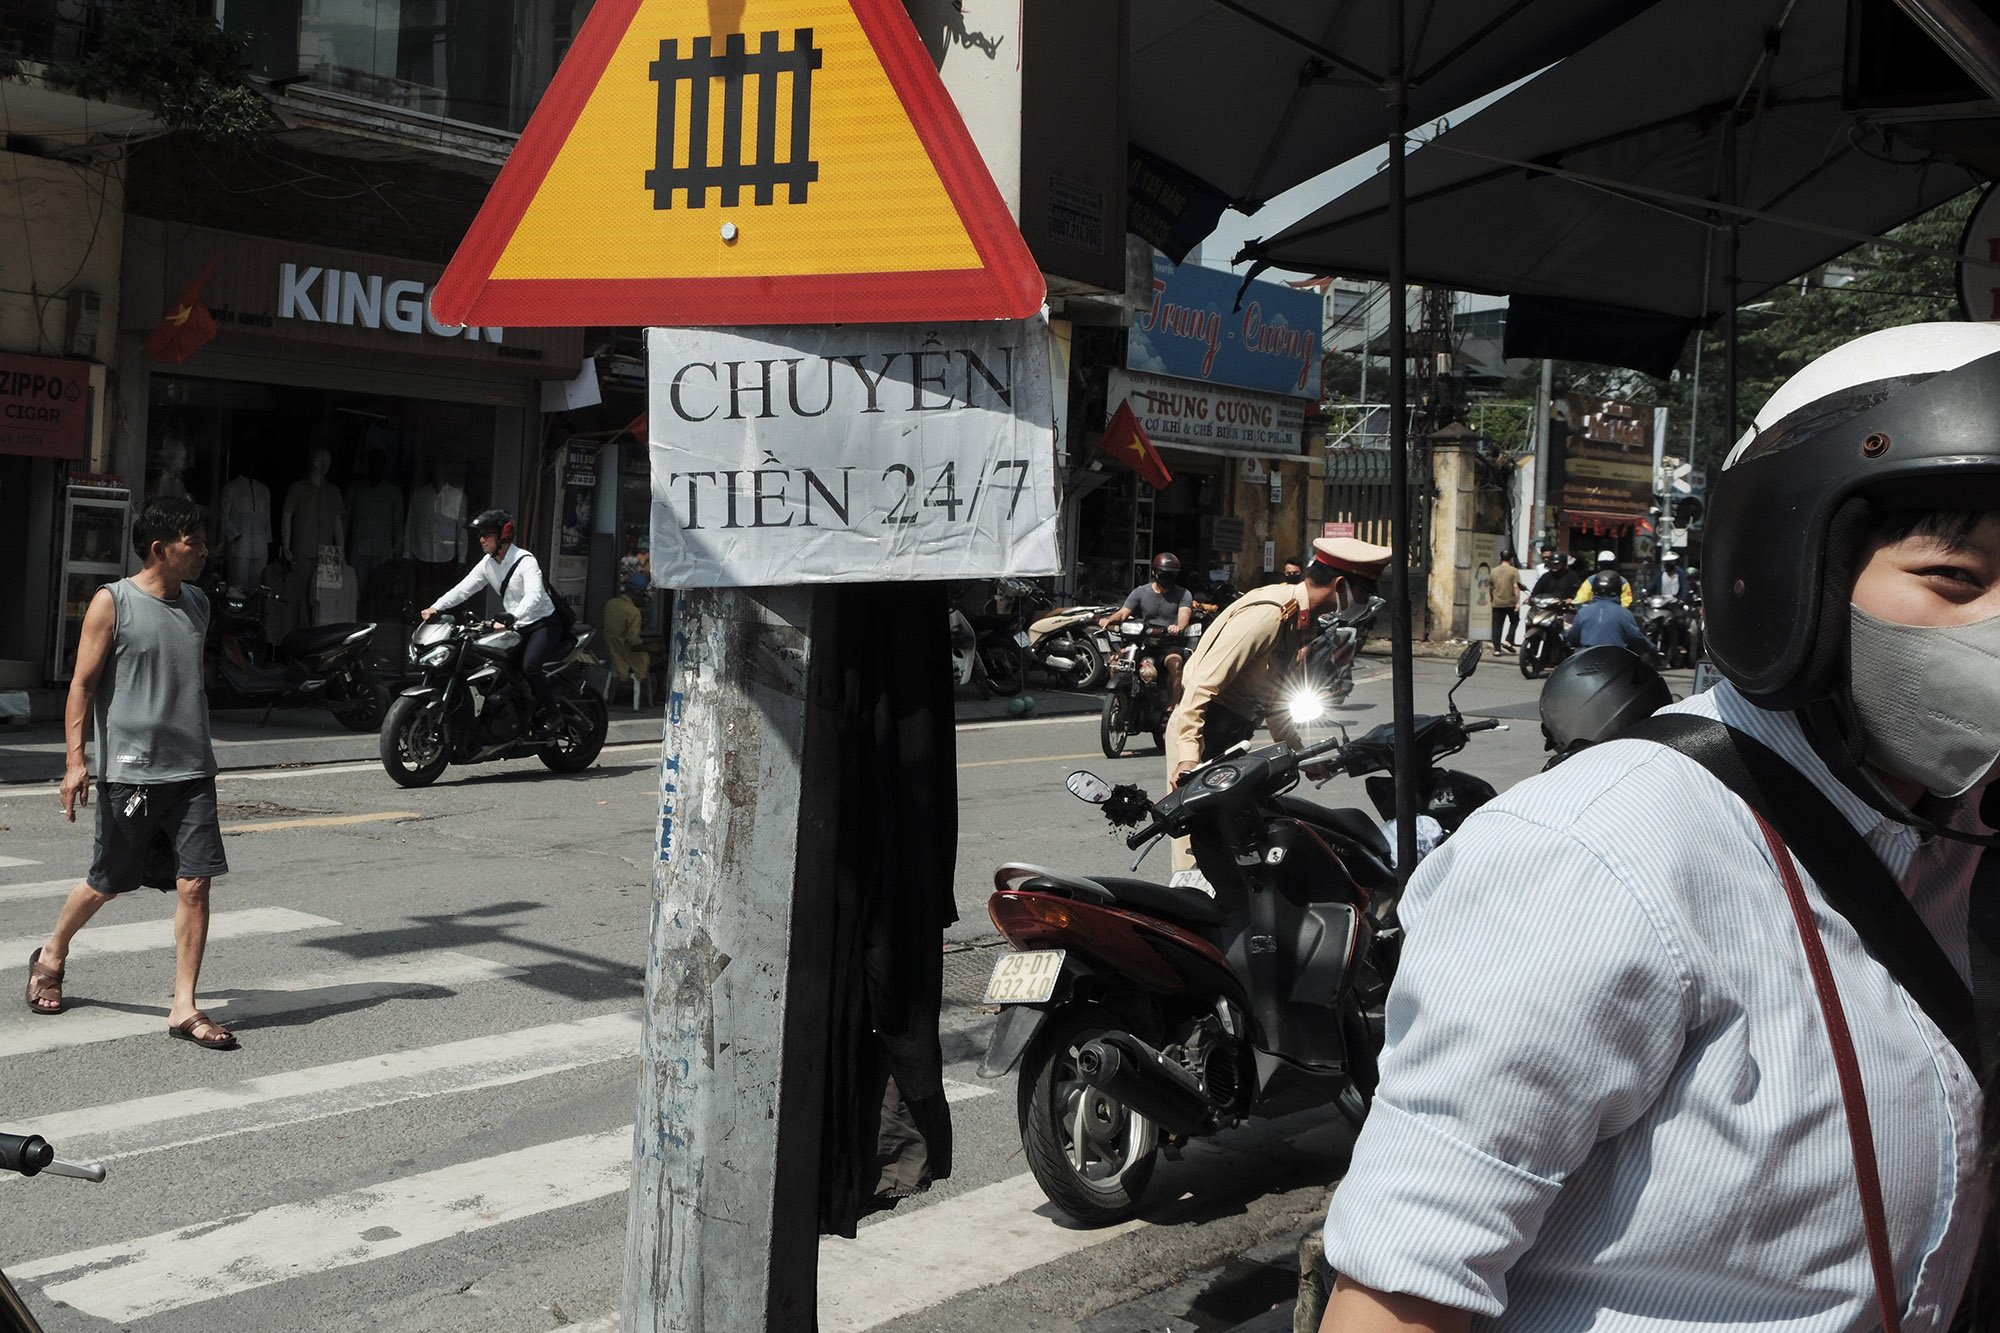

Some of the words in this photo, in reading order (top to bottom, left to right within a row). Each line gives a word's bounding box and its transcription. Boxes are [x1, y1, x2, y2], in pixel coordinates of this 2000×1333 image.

[278, 263, 503, 343] KING
[1143, 278, 1222, 378] Trung
[1242, 301, 1315, 391] Cương
[0, 370, 63, 400] ZIPPO
[670, 331, 1018, 422] CHUYỂN
[5, 404, 64, 423] CIGAR
[1147, 390, 1209, 420] TRUNG
[1215, 400, 1272, 428] CƯƠNG
[1162, 417, 1181, 433] KHÍ
[1183, 424, 1191, 434] &
[1247, 457, 1256, 474] 9
[671, 450, 856, 529] TIỀN
[881, 459, 1030, 524] 24/7
[1001, 954, 1053, 976] 29-D1
[990, 977, 1051, 999] 032.40
